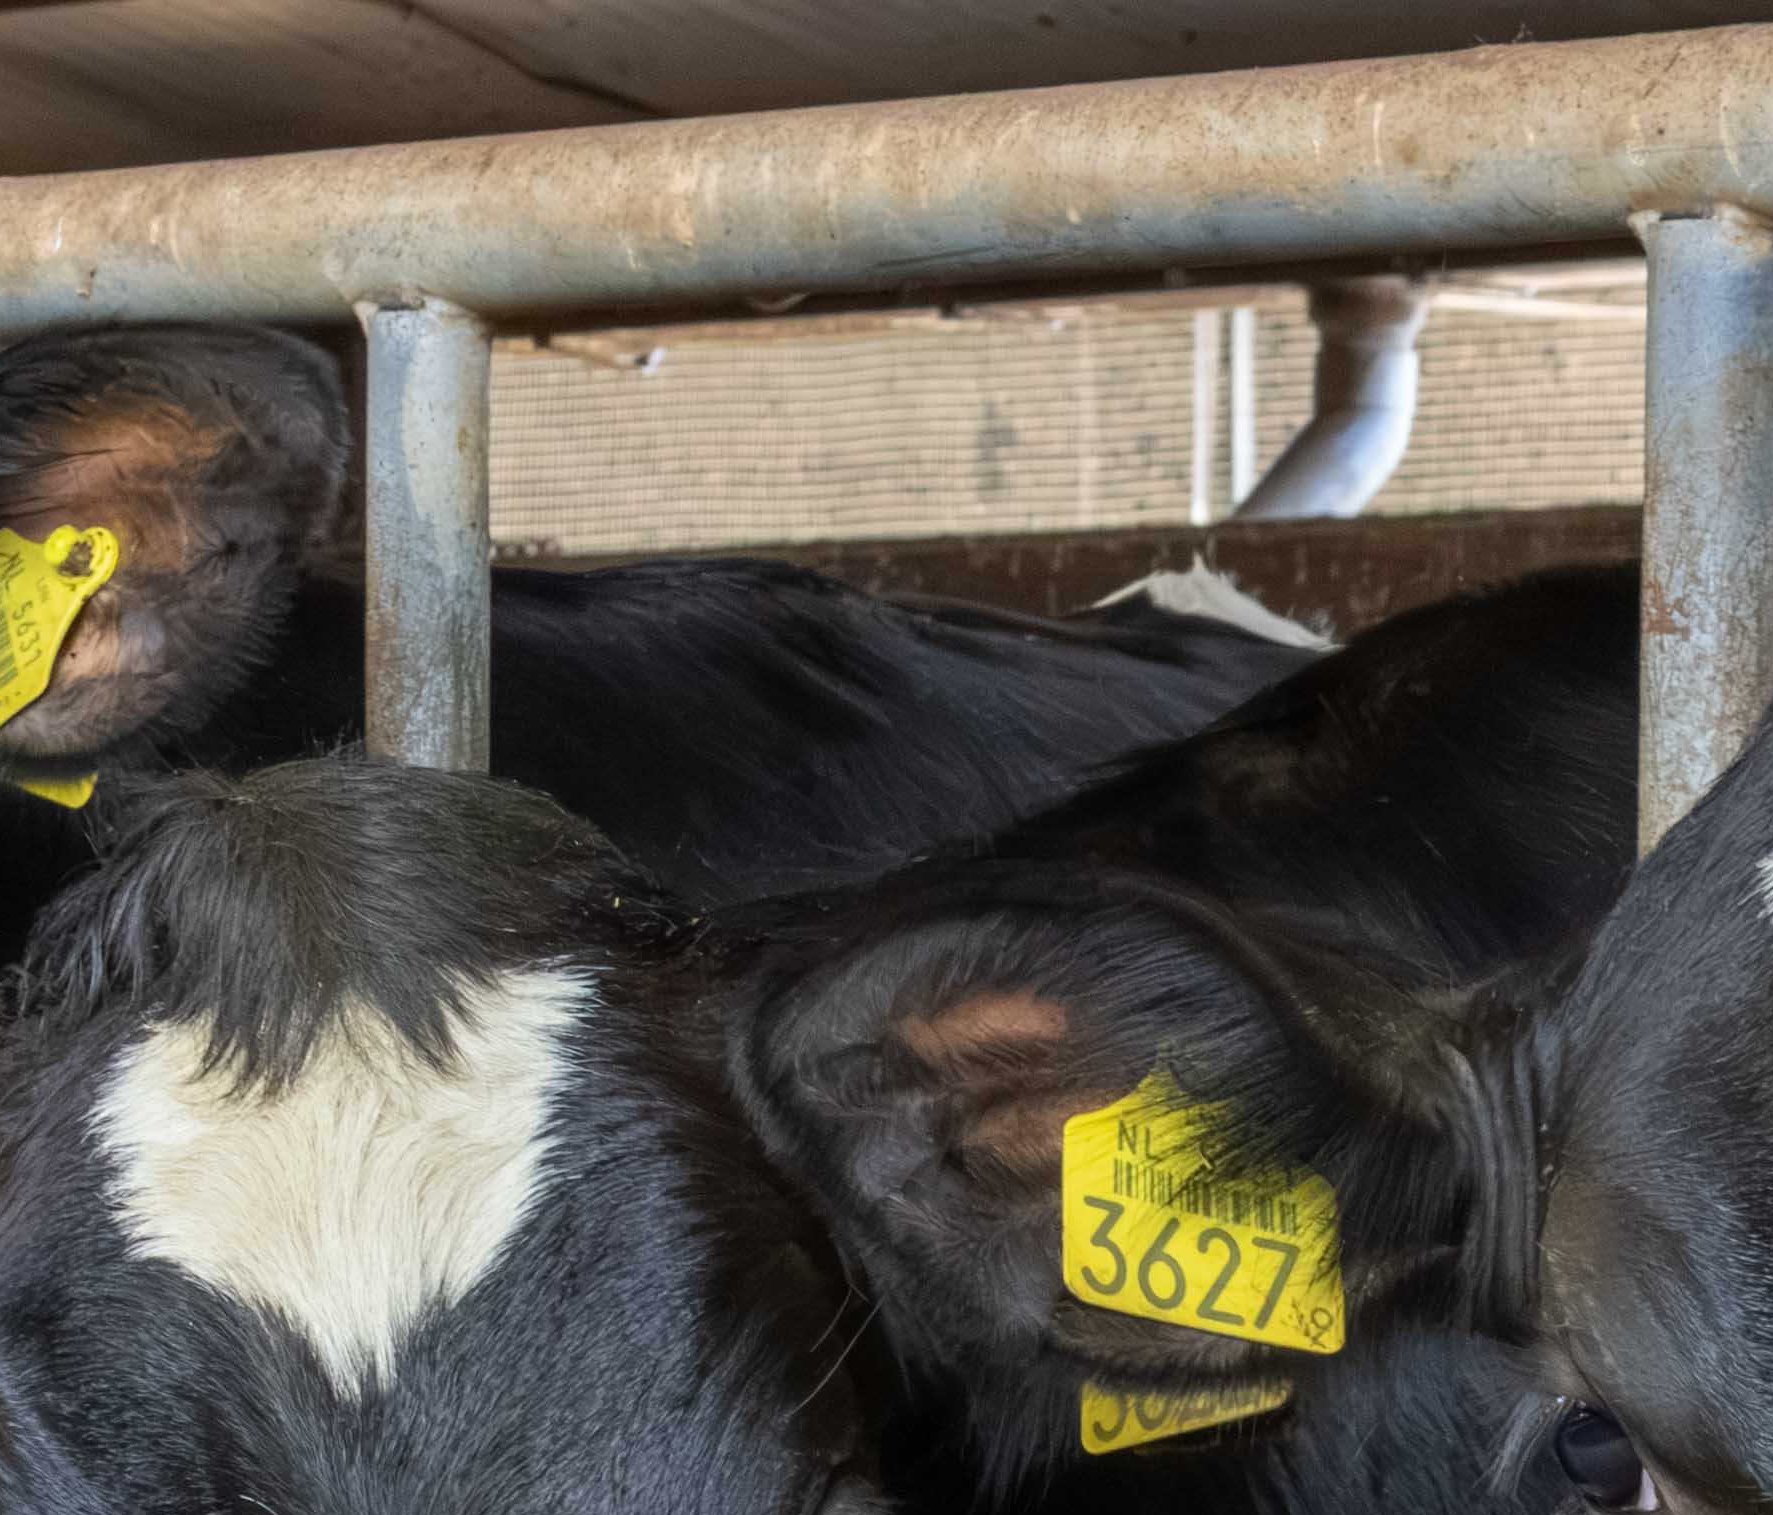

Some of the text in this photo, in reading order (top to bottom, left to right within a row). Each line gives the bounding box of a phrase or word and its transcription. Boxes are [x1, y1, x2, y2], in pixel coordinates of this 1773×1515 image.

[12, 601, 42, 667] 5631
[1117, 1120, 1161, 1159] NL
[1081, 1195, 1300, 1329] 3627
